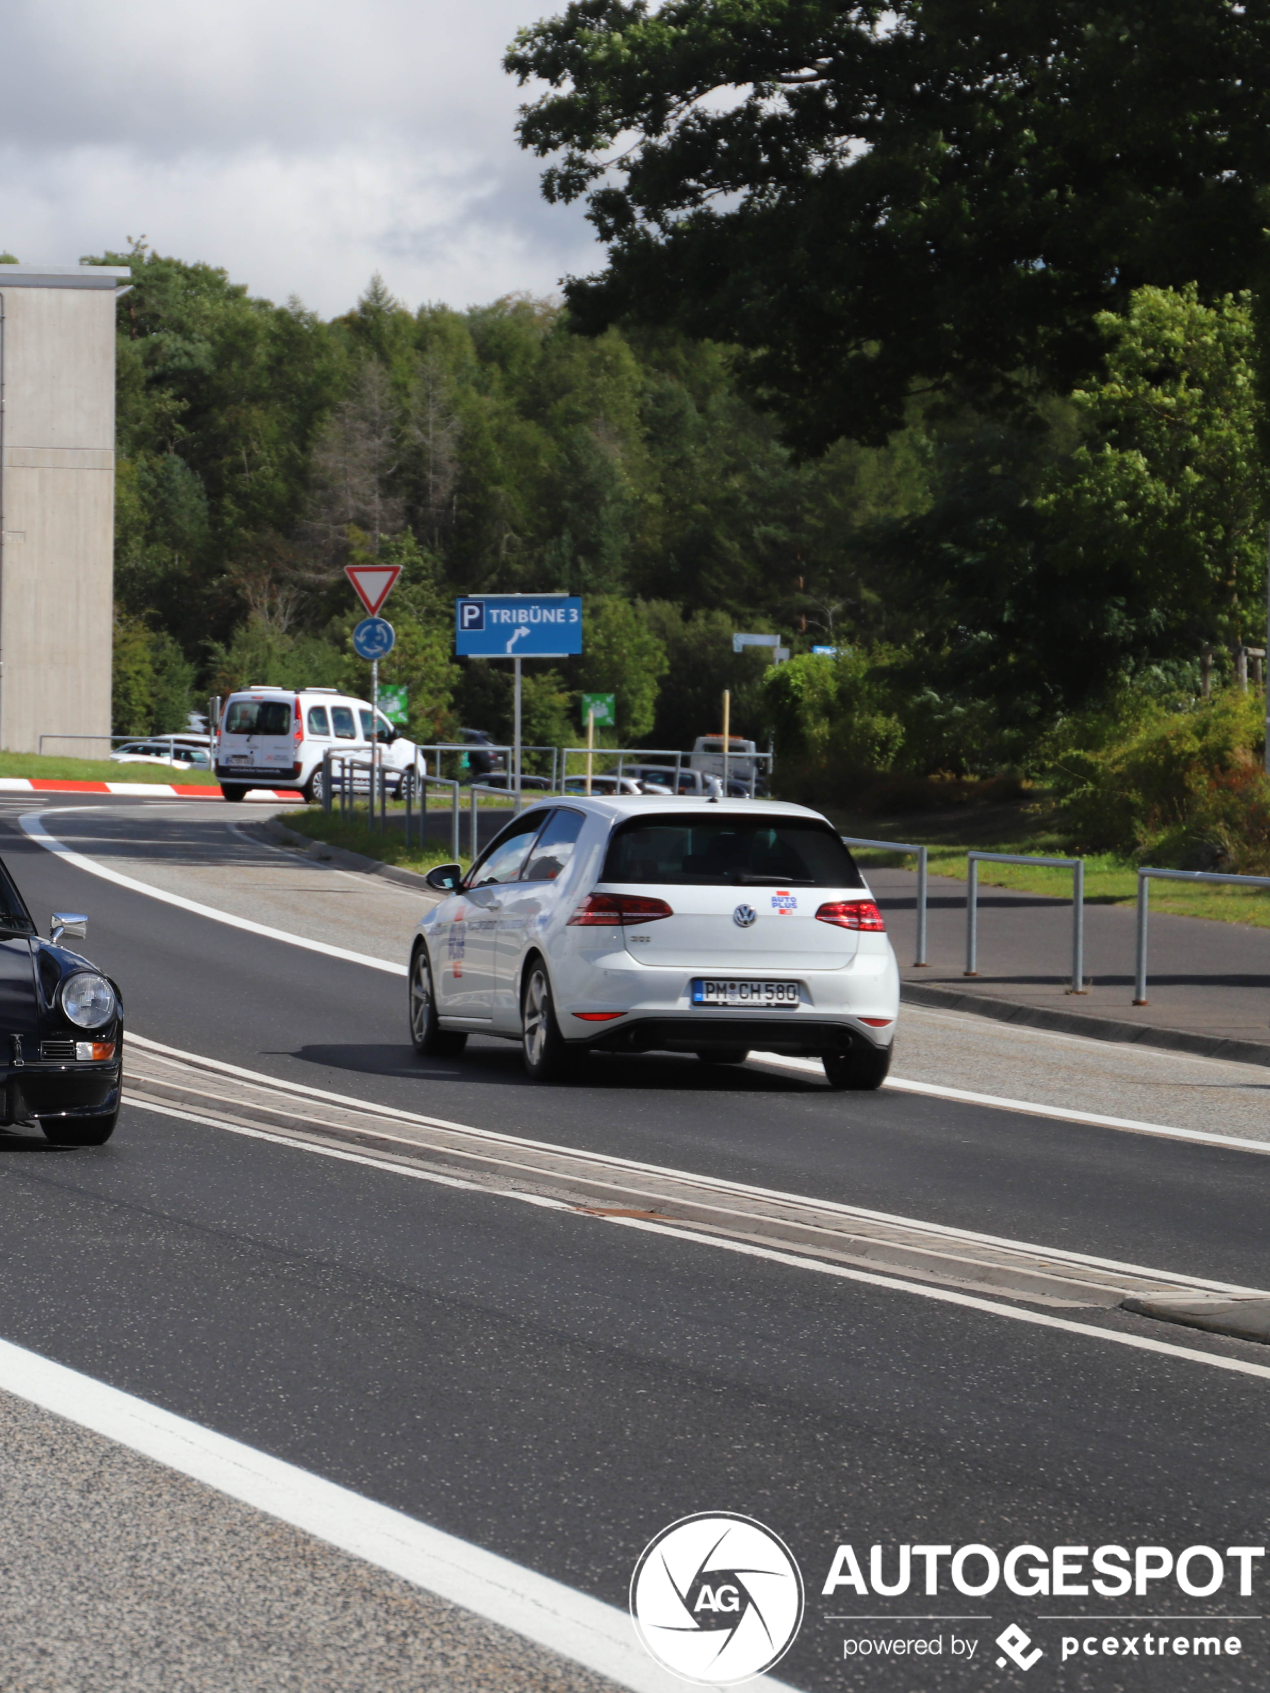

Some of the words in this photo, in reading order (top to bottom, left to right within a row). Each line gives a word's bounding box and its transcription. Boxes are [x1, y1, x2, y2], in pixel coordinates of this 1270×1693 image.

[463, 604, 480, 627] P
[489, 605, 565, 623] TRIBÜNE
[569, 608, 579, 623] 3
[705, 983, 727, 999] PM
